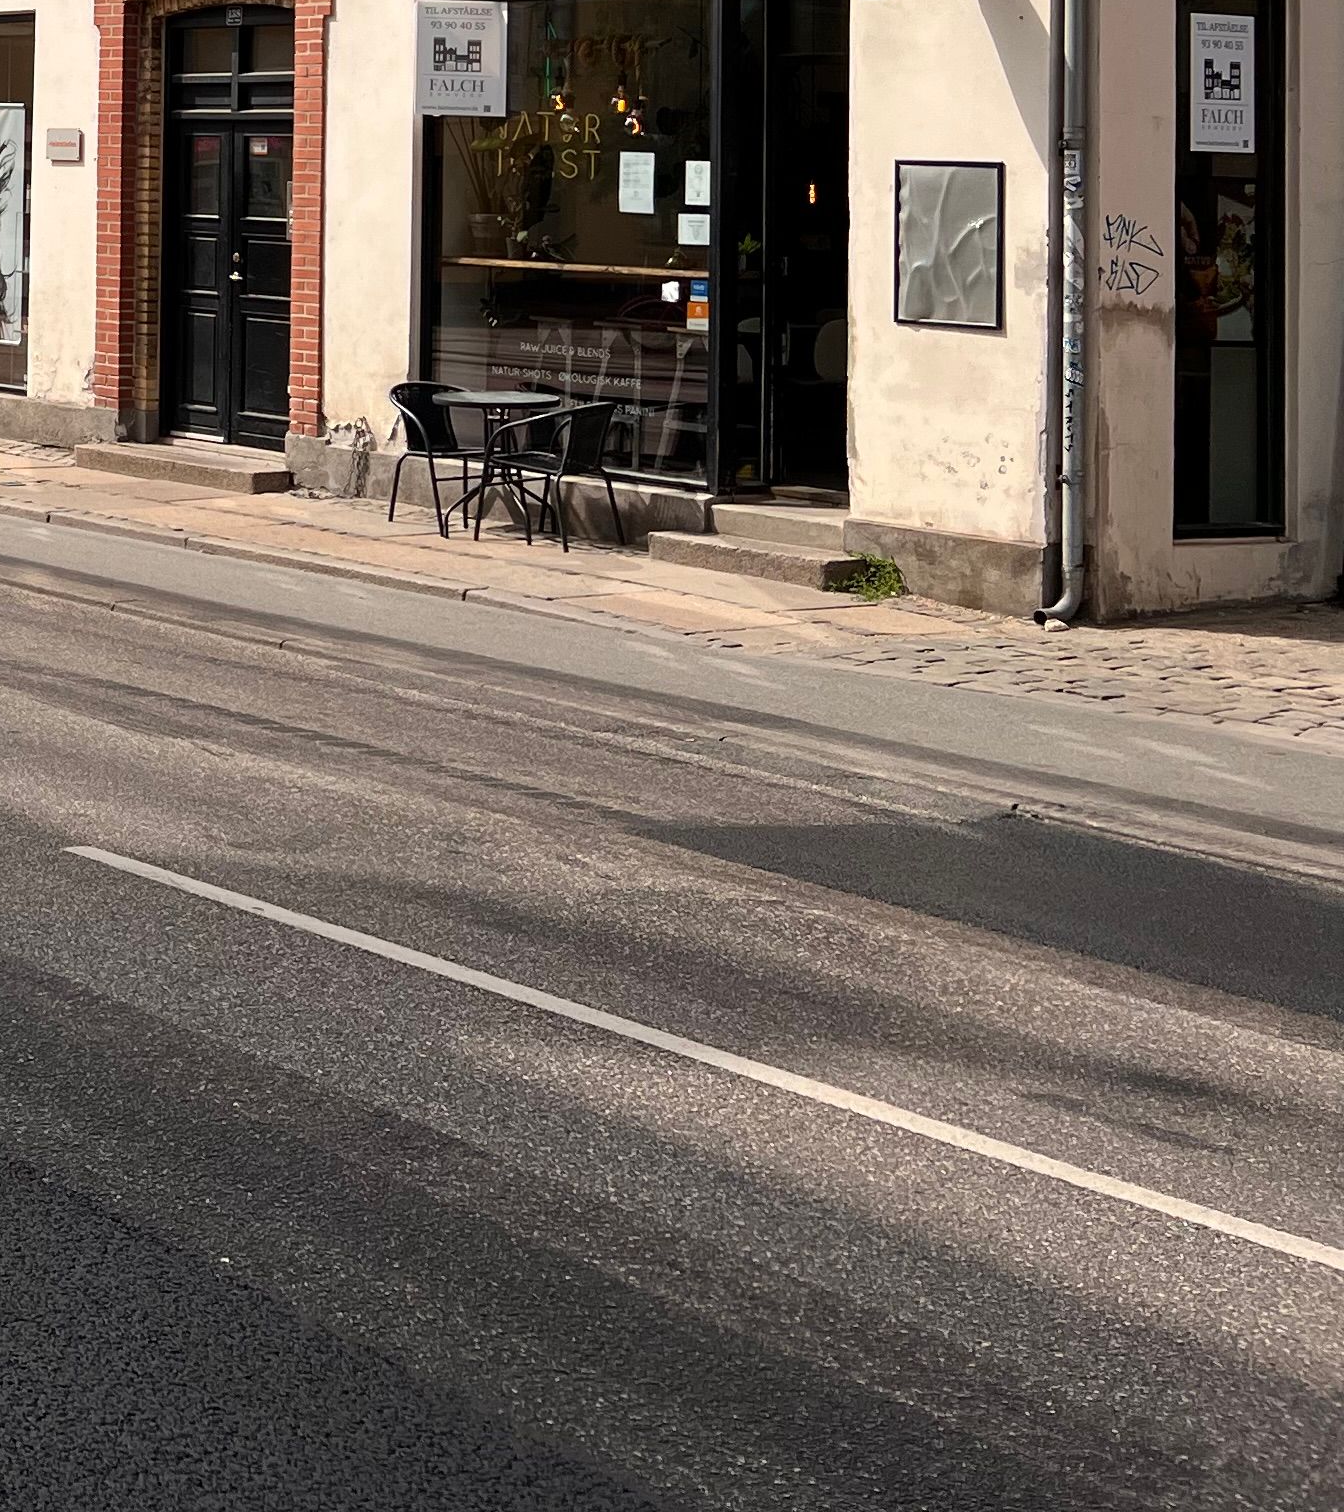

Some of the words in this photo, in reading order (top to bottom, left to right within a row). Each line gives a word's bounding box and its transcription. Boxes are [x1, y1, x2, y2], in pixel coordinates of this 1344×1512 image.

[424, 7, 440, 15] TIL
[441, 6, 493, 16] AFSTÅELSE
[430, 20, 442, 30] 93
[444, 21, 457, 30] 90
[460, 21, 472, 31] 40
[475, 22, 486, 31] 55
[1201, 39, 1211, 49] 93
[1212, 40, 1222, 49] 90
[429, 78, 486, 93] FALCH
[1201, 108, 1244, 125] FALCH
[519, 341, 540, 353] RAW
[541, 343, 566, 356] JUICE
[576, 346, 611, 359] BLENDS
[558, 371, 612, 386] ØKOLOGISK
[613, 377, 642, 390] KAFFE
